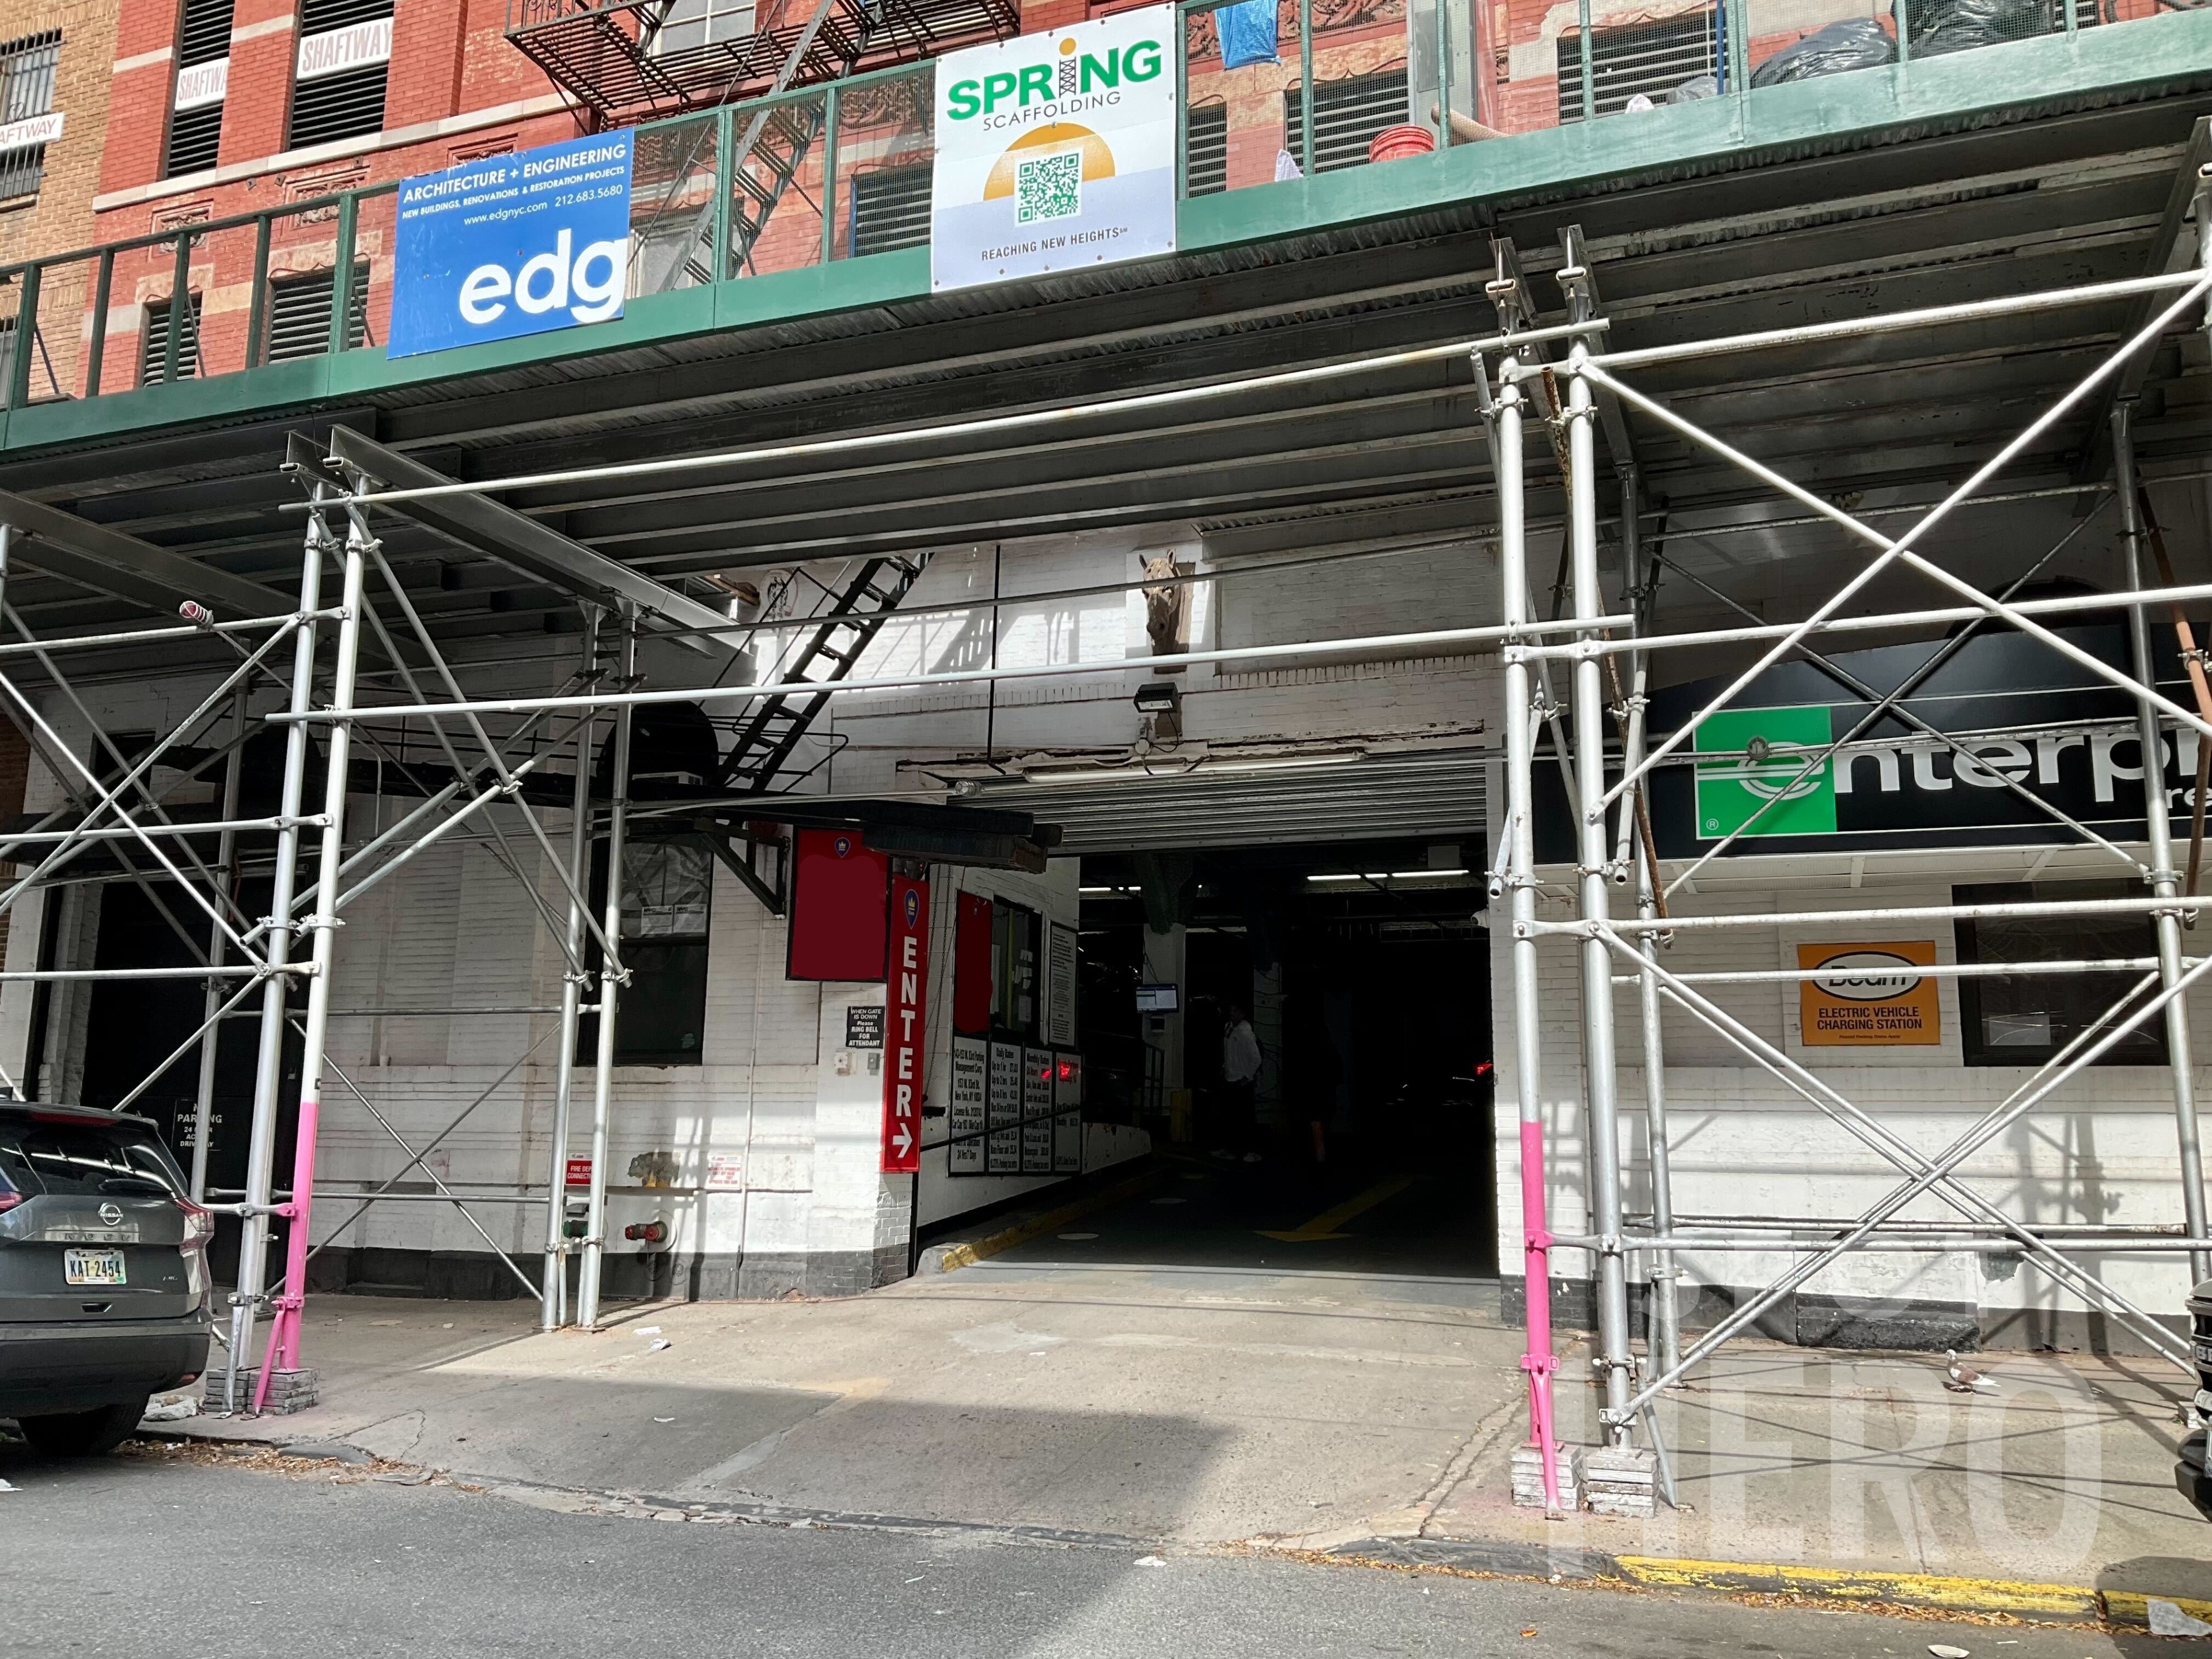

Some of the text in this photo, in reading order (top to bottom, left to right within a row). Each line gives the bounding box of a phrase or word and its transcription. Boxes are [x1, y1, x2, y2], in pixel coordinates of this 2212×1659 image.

[302, 23, 393, 72] SHAFTWAY
[179, 65, 227, 101] SHAFTWA
[983, 90, 1121, 131] SCAFFOLDING
[402, 166, 625, 219] NEW BUILDINGS, RENOVATIONS & RESTORATION PROJECTS
[403, 169, 505, 203] ARCHITECTURE
[524, 143, 626, 178] ENGINEERING
[464, 184, 623, 225] www.edgnyc.com 212.683.5680
[982, 241, 1037, 260] REACHING
[1041, 236, 1066, 250] NEW
[459, 228, 628, 324] edg
[896, 935, 918, 1118] ENTER
[1817, 1018, 1922, 1030] CHARGING STATION
[1819, 1007, 1919, 1018] ELECTRIC VEHICLE
[177, 1114, 222, 1123] PARNG
[70, 1260, 120, 1277] KAT 2454
